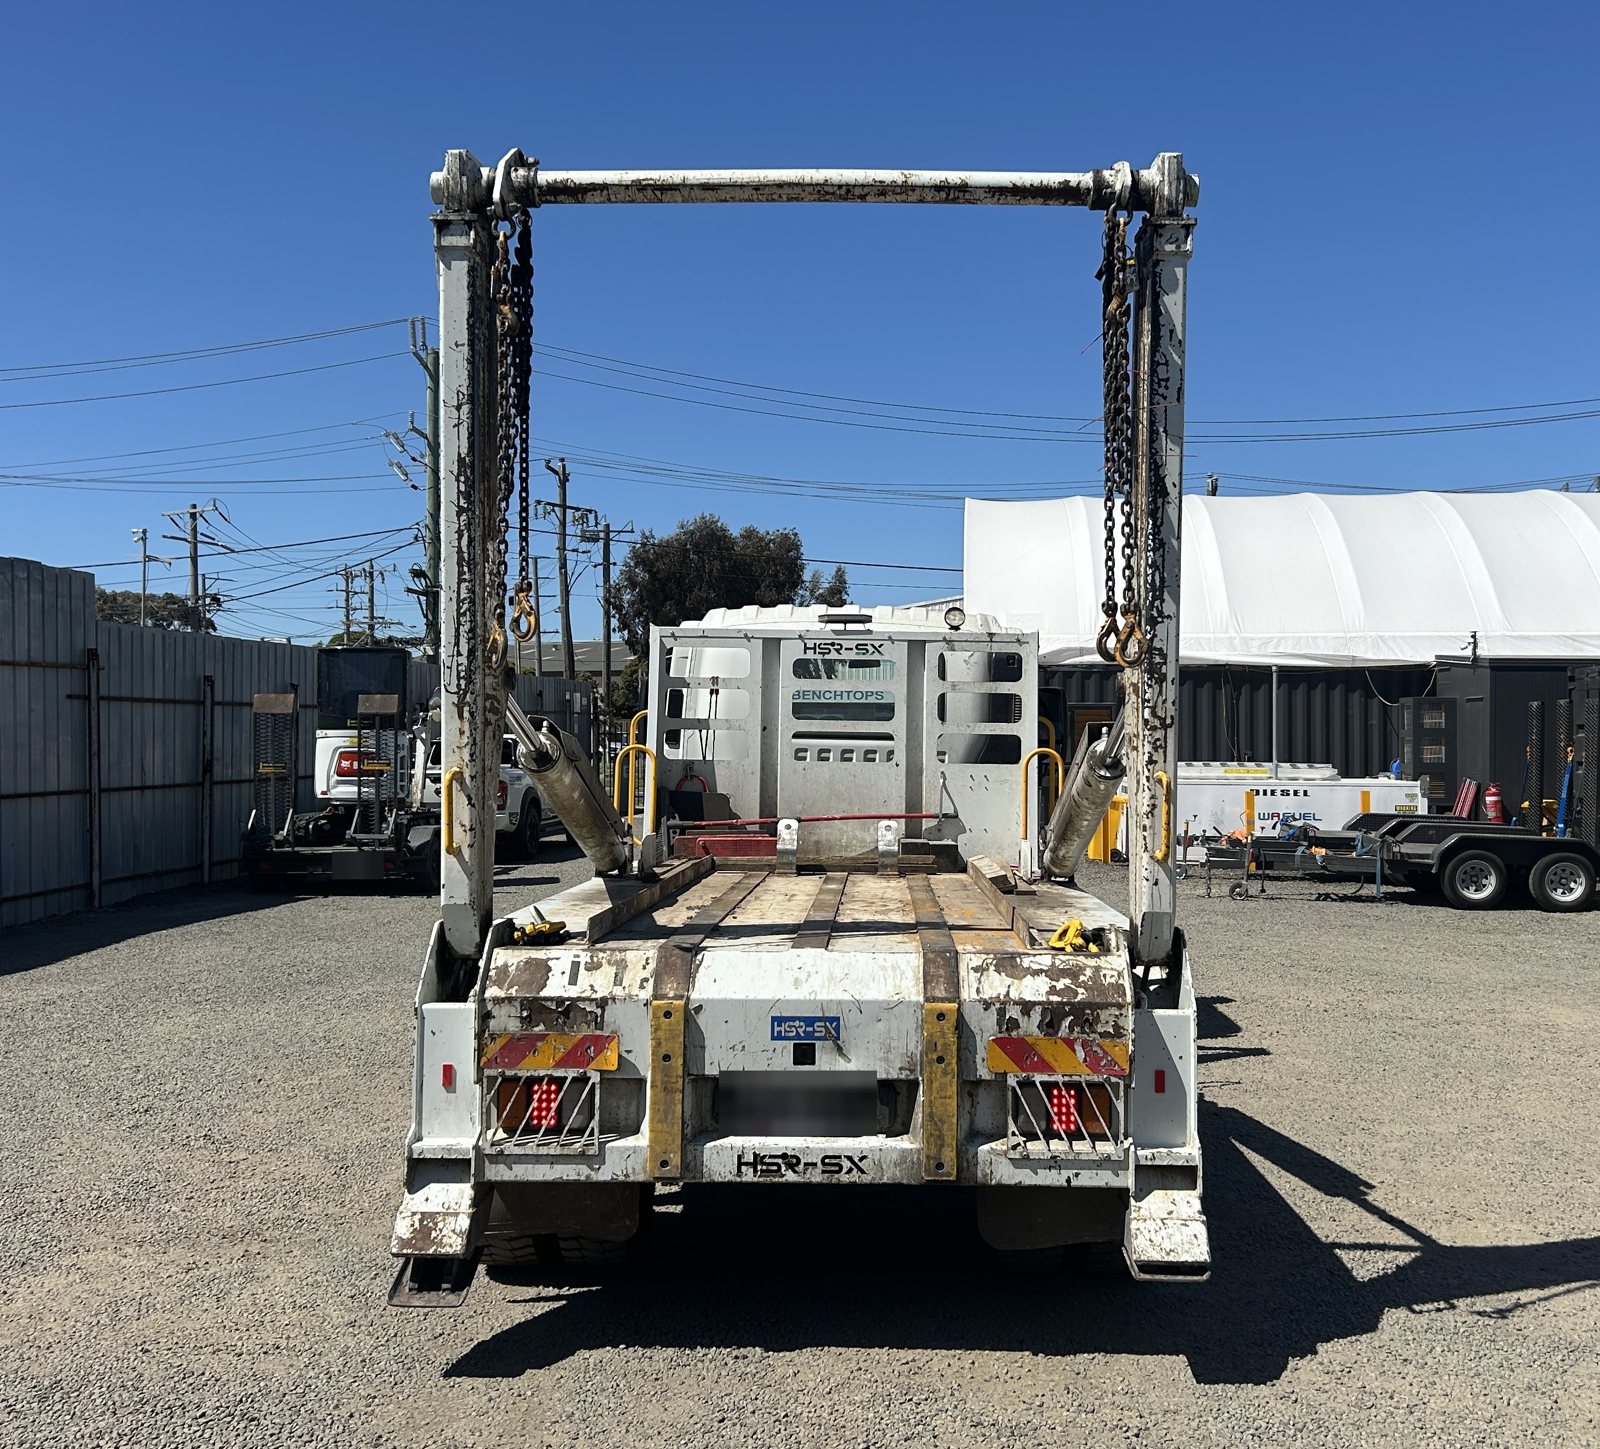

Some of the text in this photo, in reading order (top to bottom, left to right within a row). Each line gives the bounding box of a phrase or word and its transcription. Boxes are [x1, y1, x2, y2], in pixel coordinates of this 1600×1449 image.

[803, 642, 885, 656] HSR-SX
[792, 690, 884, 701] BENCHTOPS
[774, 1020, 838, 1037] HSR-SX
[736, 1152, 869, 1176] HSR-SX
